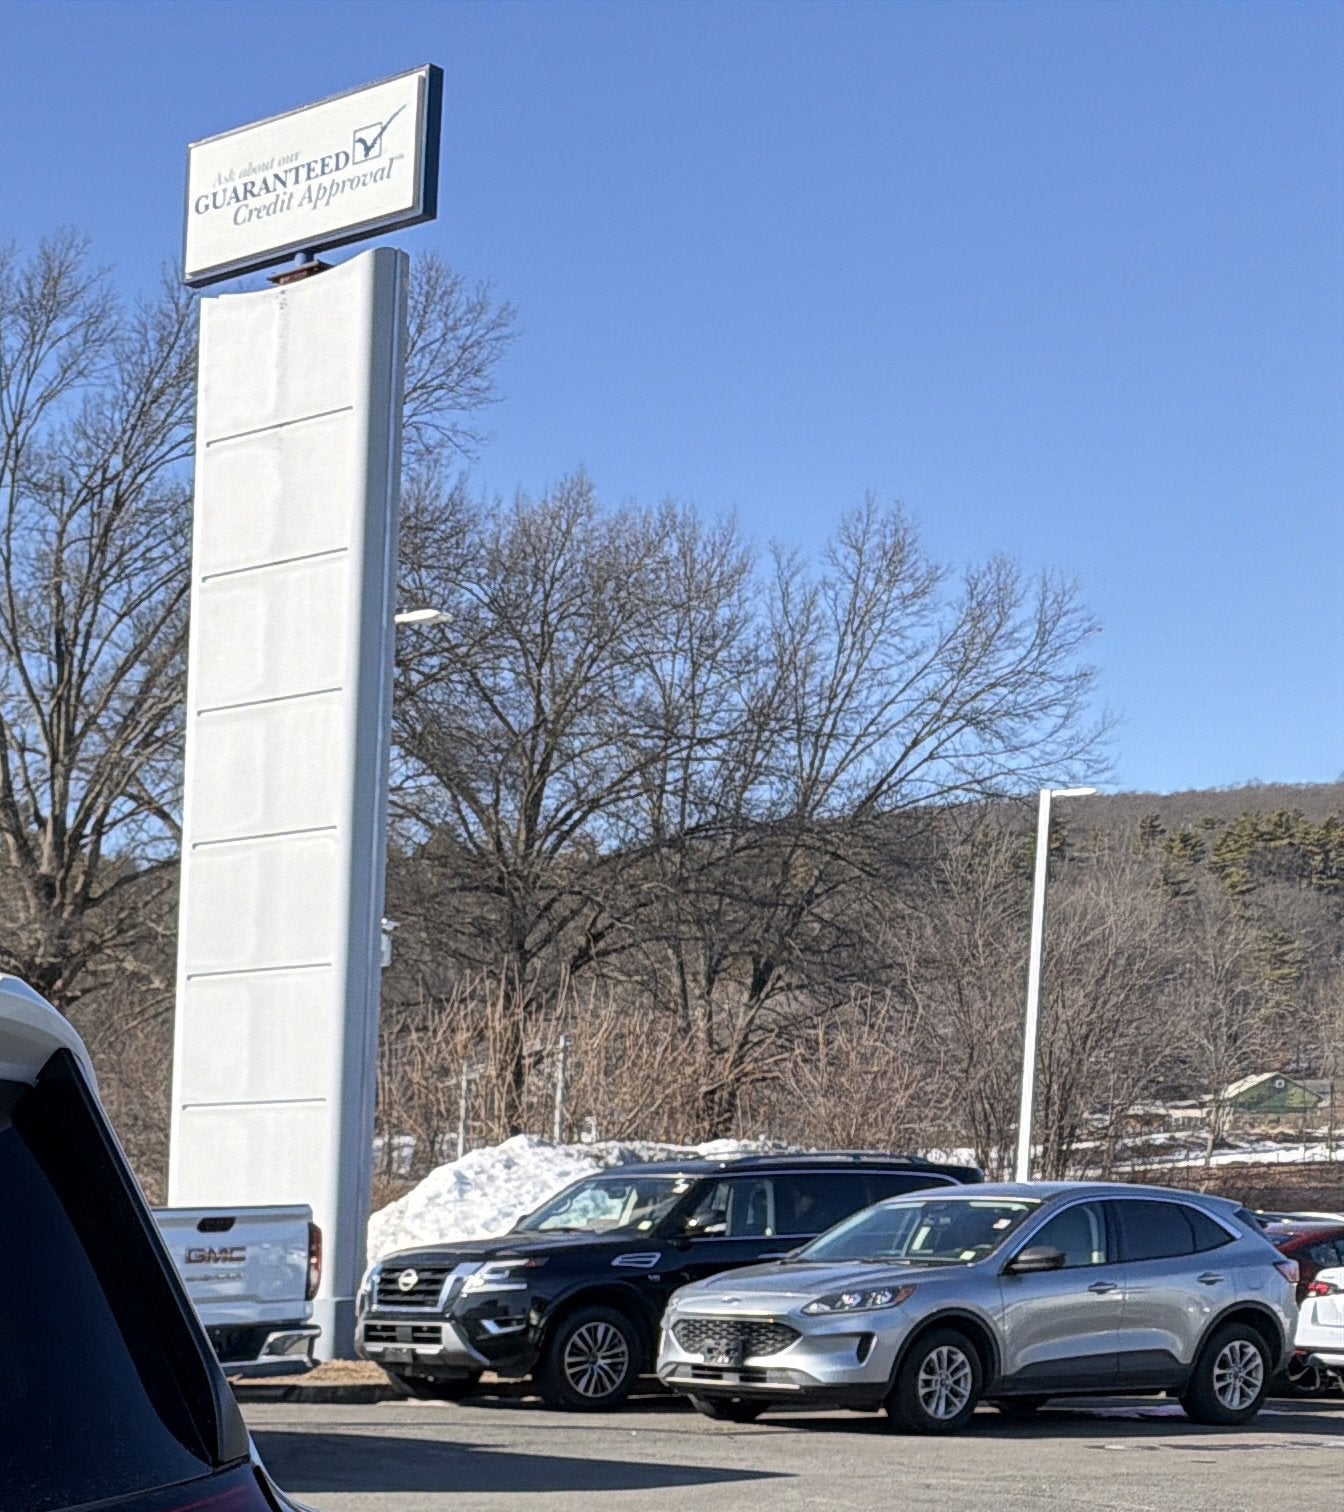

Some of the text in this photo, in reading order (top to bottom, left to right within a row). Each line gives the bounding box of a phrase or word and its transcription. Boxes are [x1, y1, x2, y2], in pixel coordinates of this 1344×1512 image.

[194, 150, 350, 215] GUARANTEED
[213, 151, 302, 189] Ask about our
[232, 157, 395, 226] Credit Approval
[185, 1246, 247, 1265] GMC
